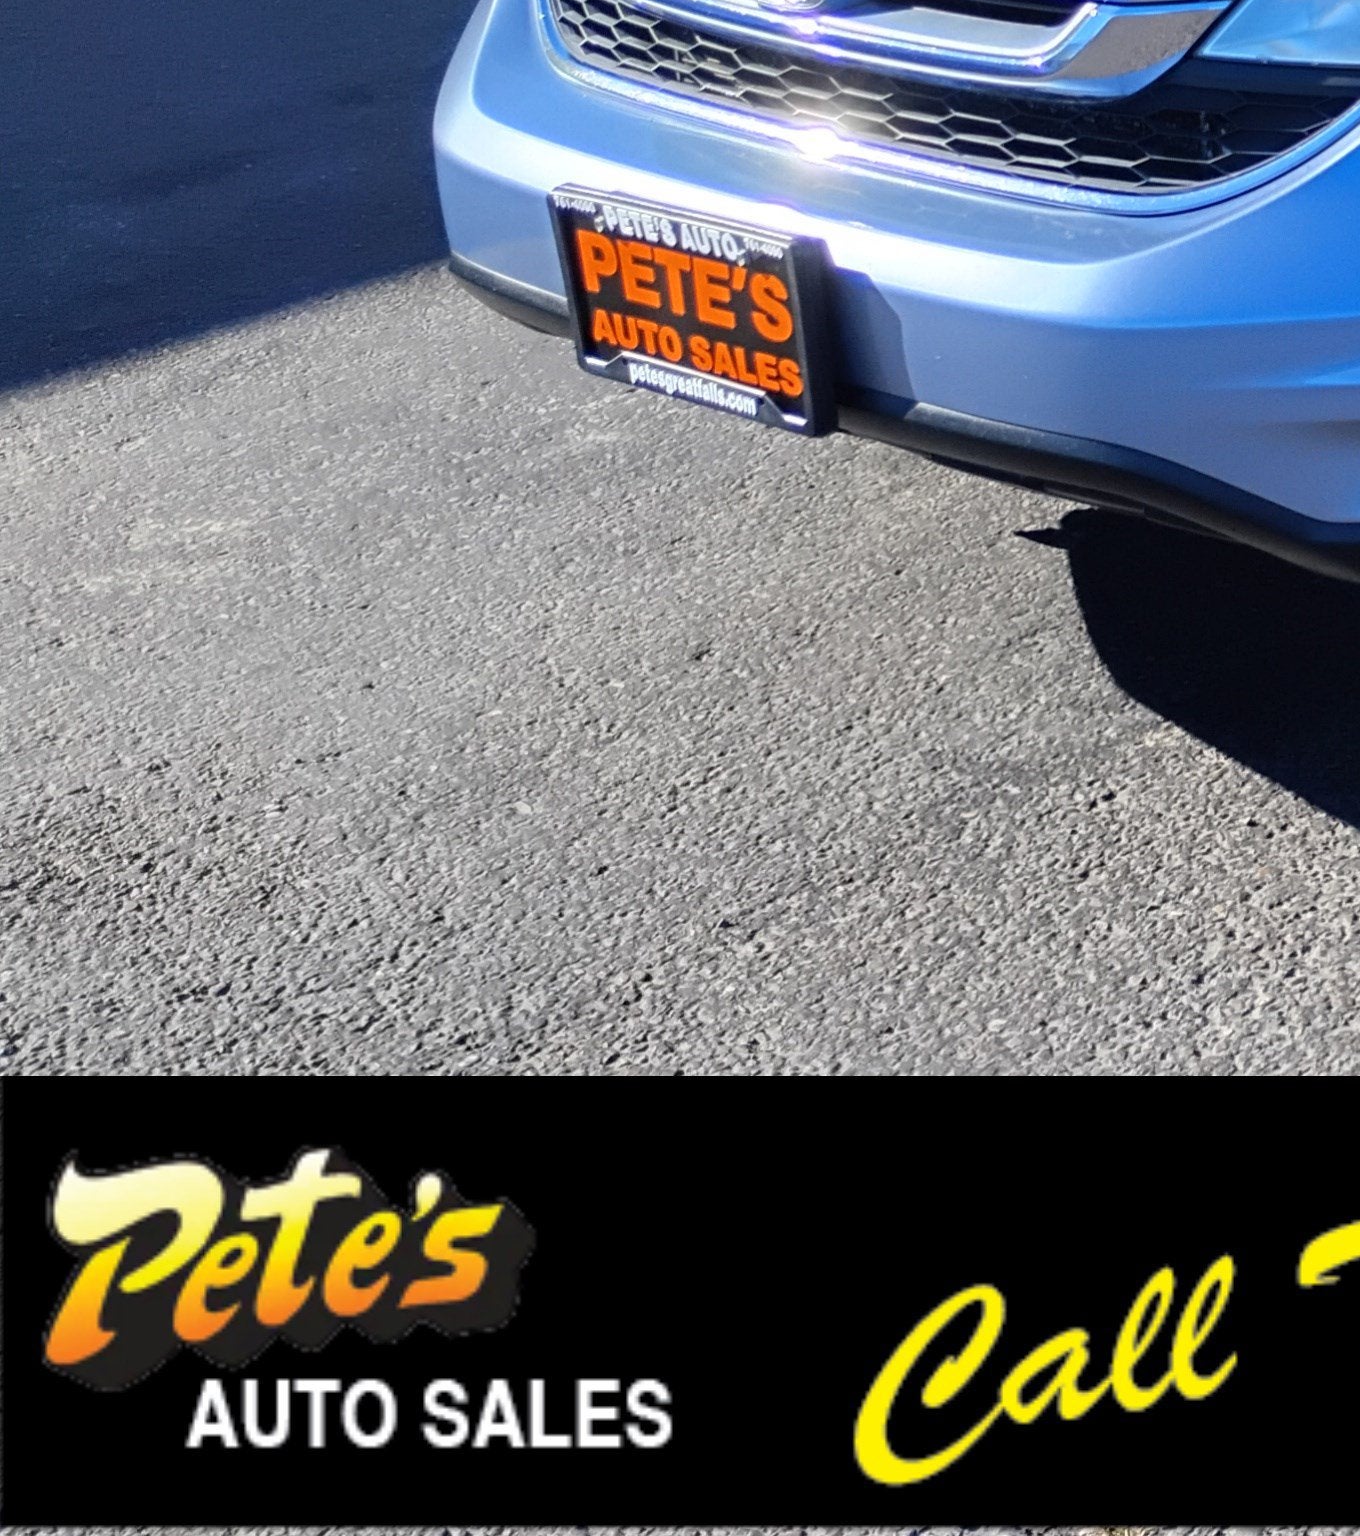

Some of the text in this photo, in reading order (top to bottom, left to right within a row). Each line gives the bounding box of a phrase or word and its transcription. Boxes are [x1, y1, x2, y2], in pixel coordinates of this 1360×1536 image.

[602, 204, 678, 248] PETE'S
[680, 223, 741, 261] AUTO
[575, 228, 795, 343] PETE'S
[591, 308, 805, 397] AUTO SALES
[629, 363, 757, 416] petesgreatfalls.com
